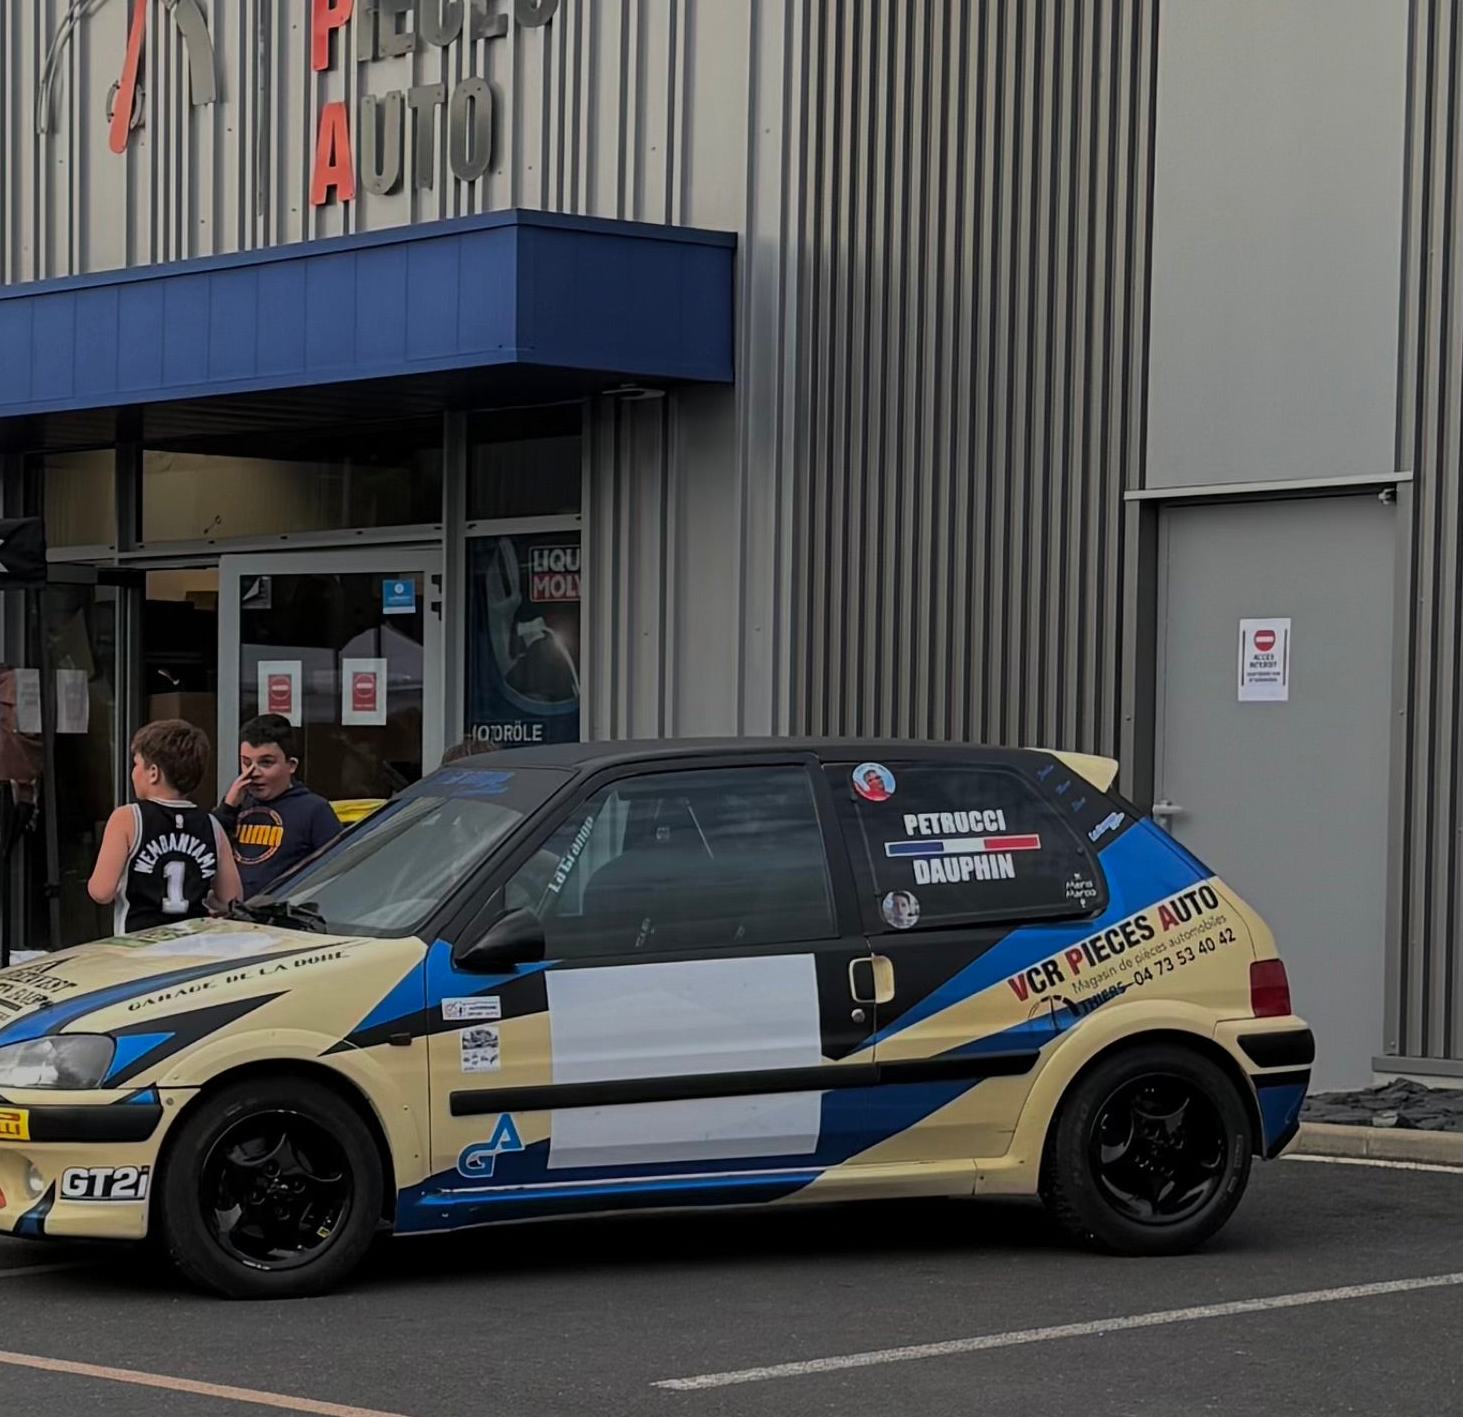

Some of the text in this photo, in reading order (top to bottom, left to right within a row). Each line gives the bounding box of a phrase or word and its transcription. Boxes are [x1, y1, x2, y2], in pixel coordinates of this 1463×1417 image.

[310, 77, 493, 207] AUTO
[235, 824, 284, 848] UMA
[903, 809, 1007, 836] PETRUCCI
[161, 860, 190, 914] 1
[912, 853, 1016, 885] DAUPHIN
[1007, 885, 1220, 1002] VCR PIECES AUTO
[1072, 965, 1117, 994] Magasin
[1119, 958, 1133, 972] de
[1169, 914, 1228, 948] automobiles
[1133, 967, 1154, 986] 04
[1154, 957, 1175, 976] 73
[1177, 947, 1196, 966] 53
[1198, 937, 1216, 955] 40
[1219, 927, 1237, 945] 42
[61, 1165, 151, 1198] GT2i
